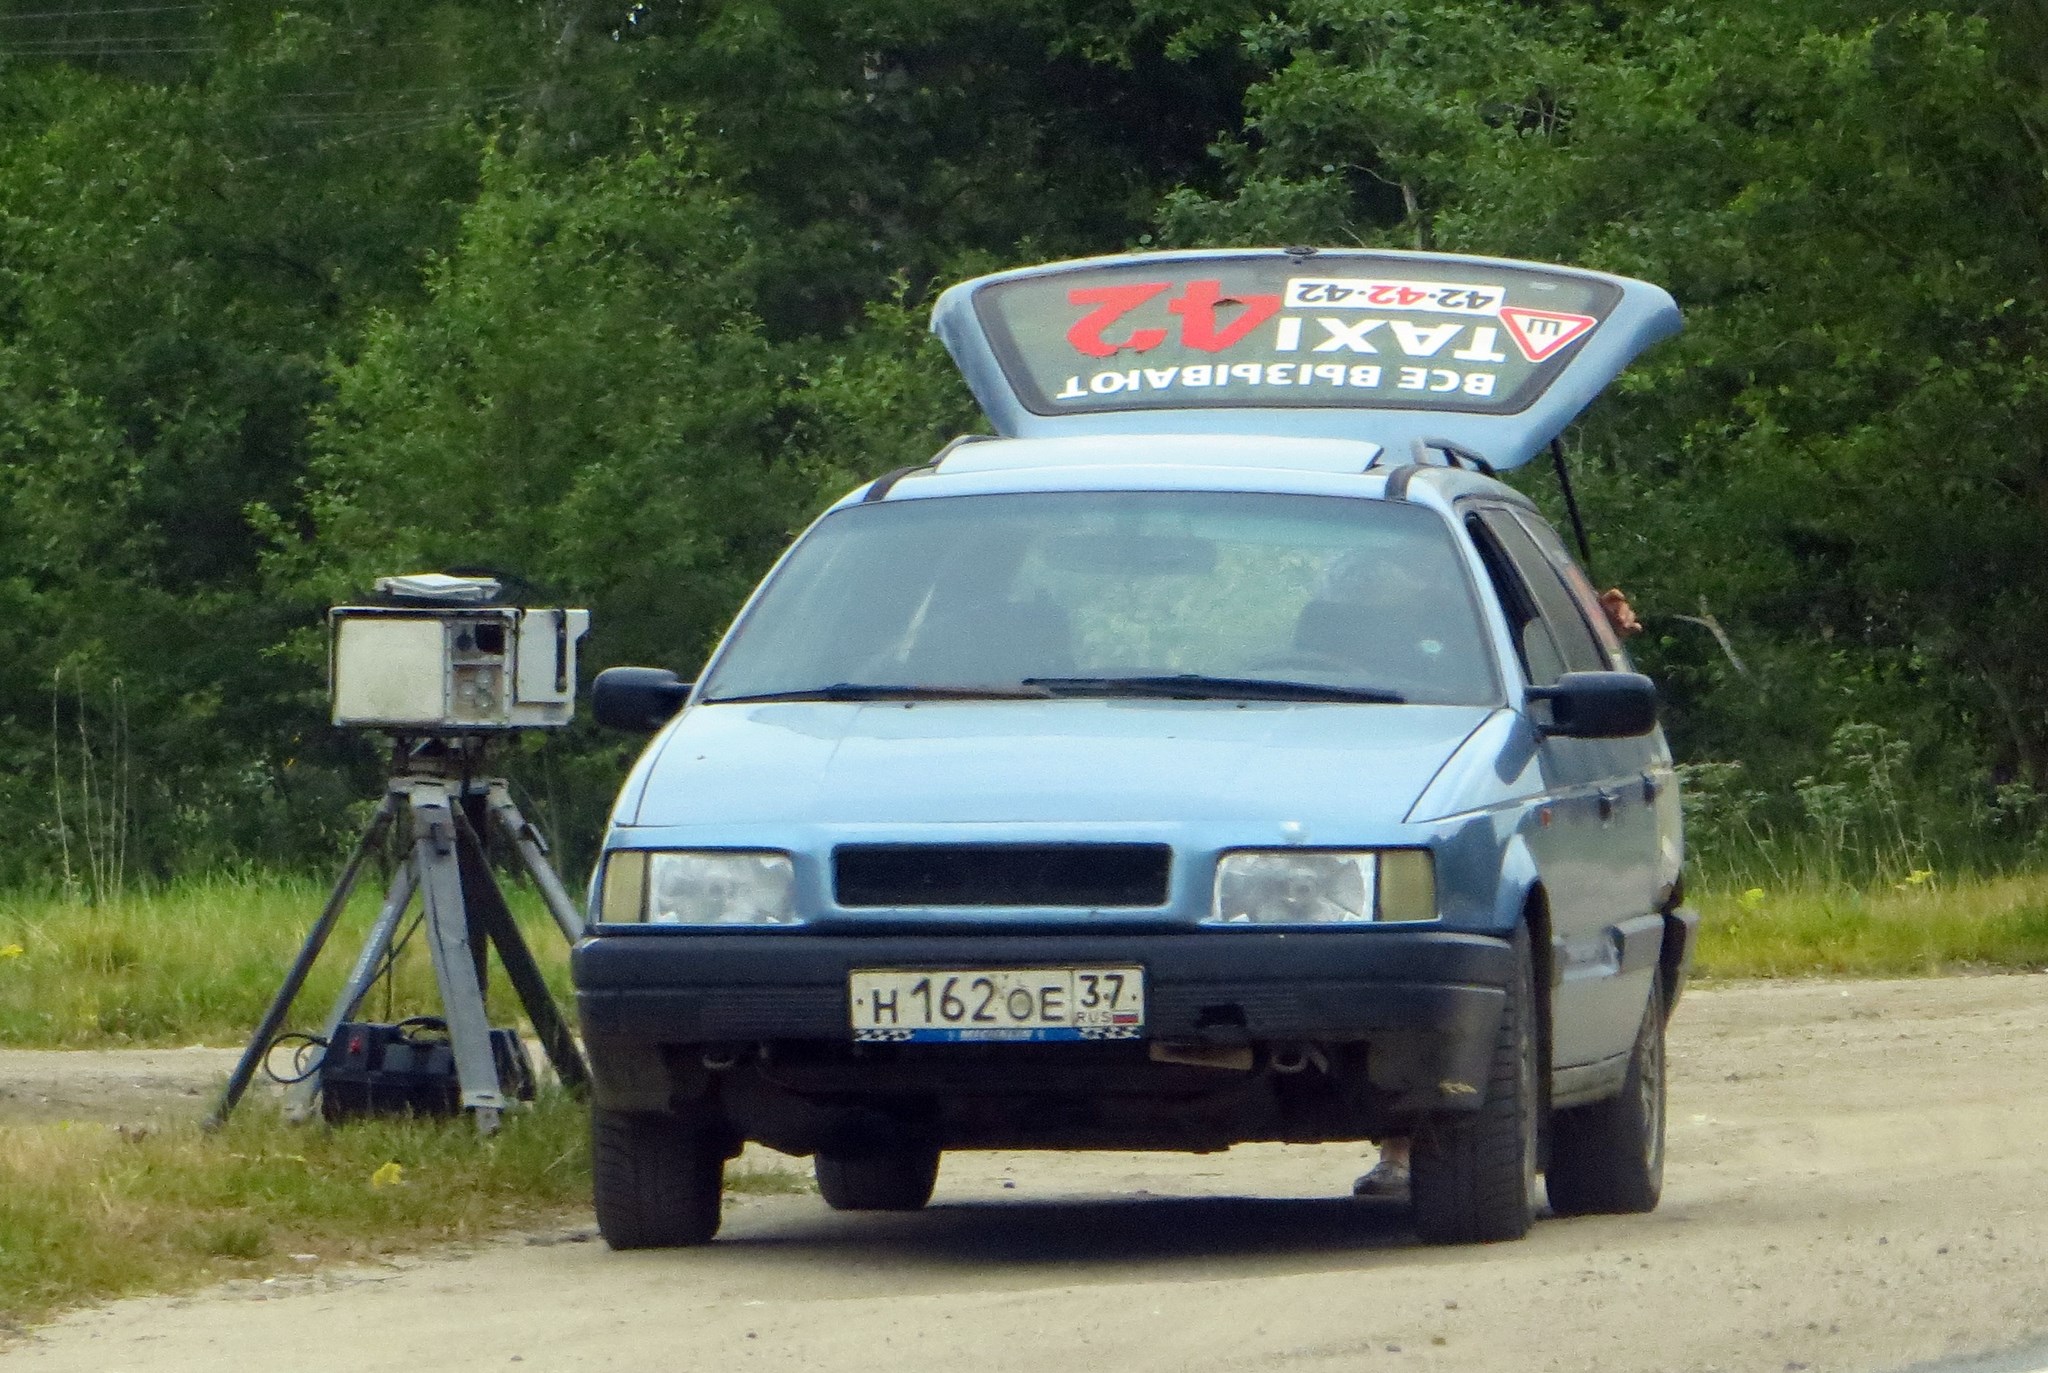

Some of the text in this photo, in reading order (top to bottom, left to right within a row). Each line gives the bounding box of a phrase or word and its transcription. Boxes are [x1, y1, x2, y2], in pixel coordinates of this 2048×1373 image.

[1065, 279, 1506, 363] TAXI 42
[1055, 362, 1497, 400] ВСЕ ВЫЗЫВАЮТ
[1079, 974, 1125, 1010] 37
[1075, 1010, 1112, 1024] RUS
